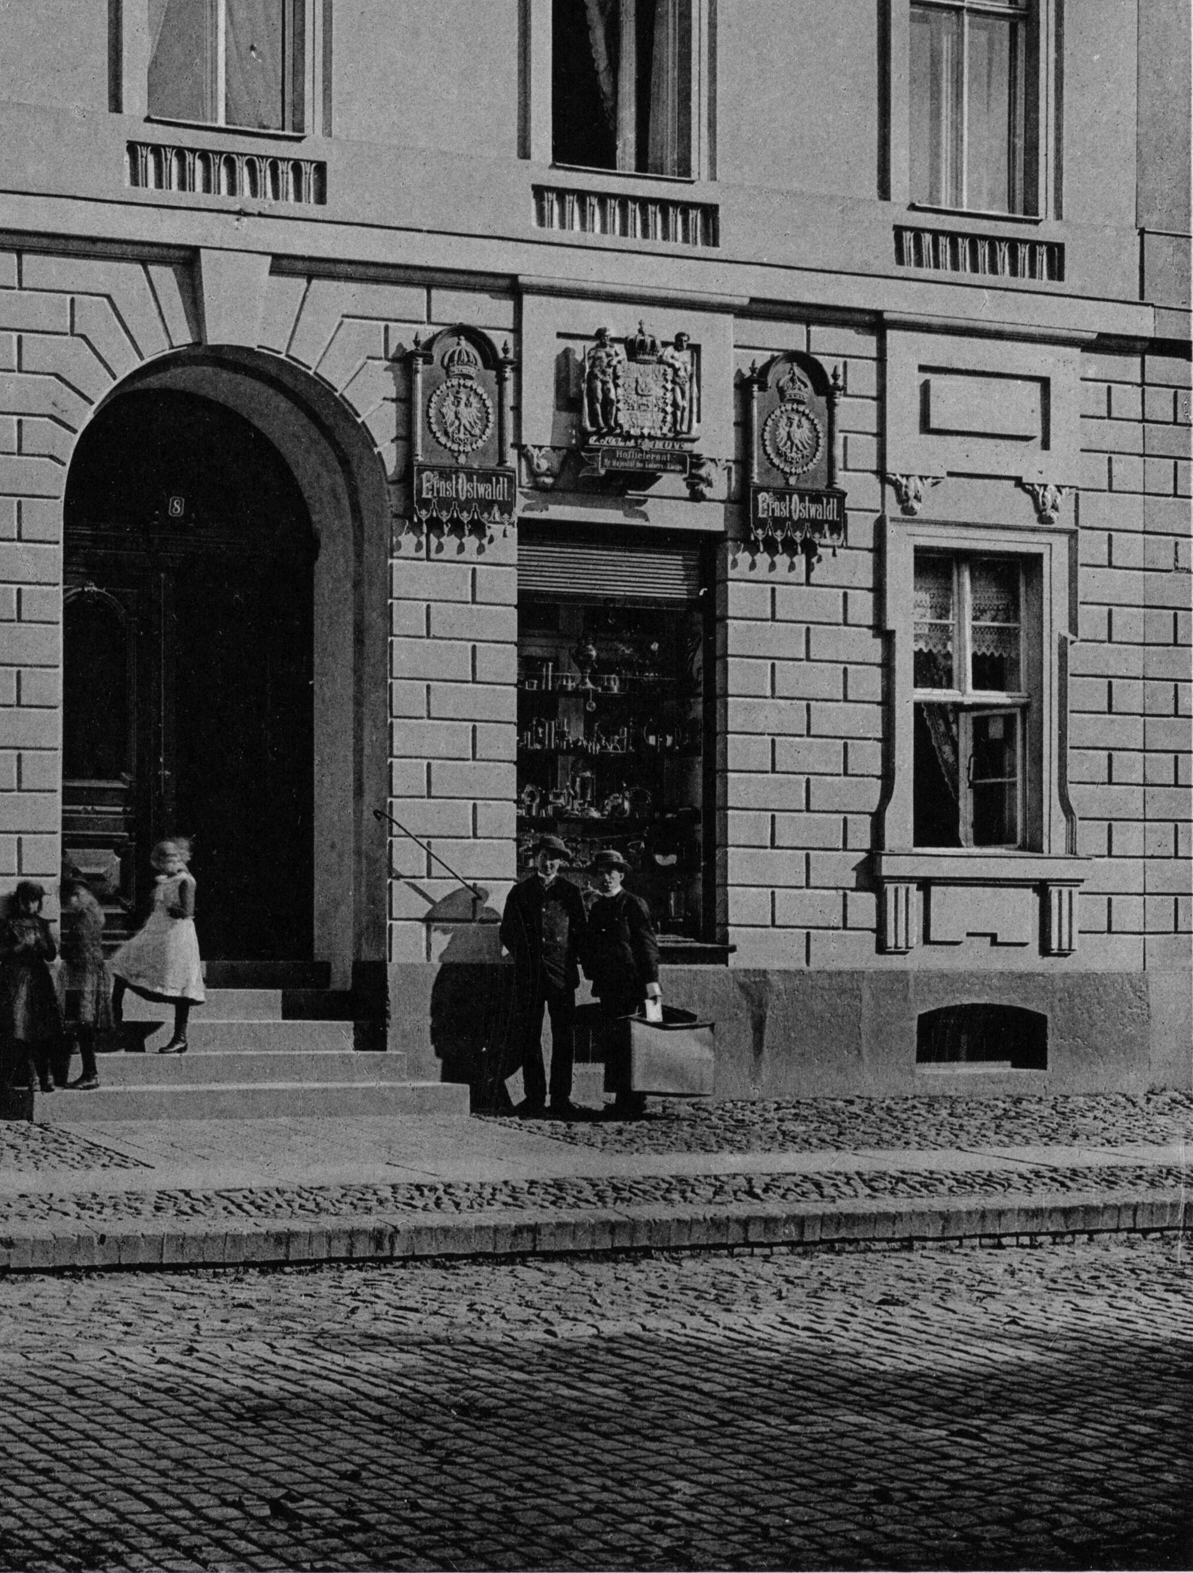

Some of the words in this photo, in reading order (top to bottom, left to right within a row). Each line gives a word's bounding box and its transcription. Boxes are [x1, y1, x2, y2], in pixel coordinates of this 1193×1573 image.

[421, 470, 456, 498] Ernst
[172, 499, 181, 514] 8
[757, 491, 790, 518] Ernst
